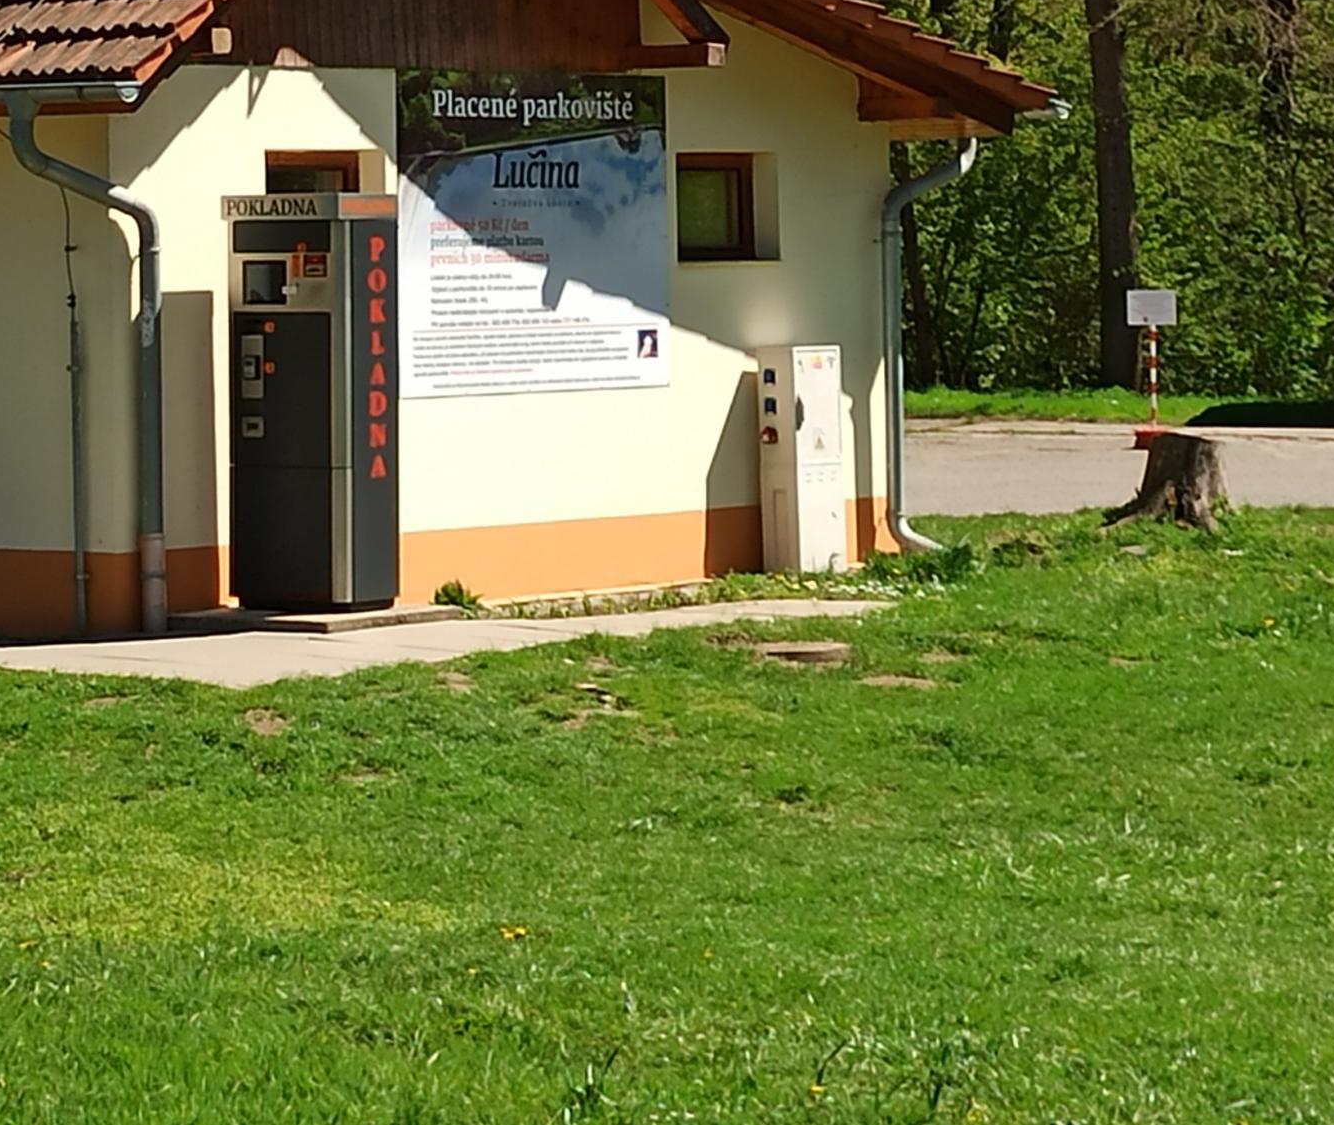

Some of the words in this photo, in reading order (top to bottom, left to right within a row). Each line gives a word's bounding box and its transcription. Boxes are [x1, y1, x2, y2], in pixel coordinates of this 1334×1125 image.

[431, 87, 517, 119] Placené
[522, 91, 634, 126] parkoviště
[492, 149, 580, 190] Lučina
[226, 198, 318, 217] POKLADNA
[366, 235, 388, 479] POKLADNA
